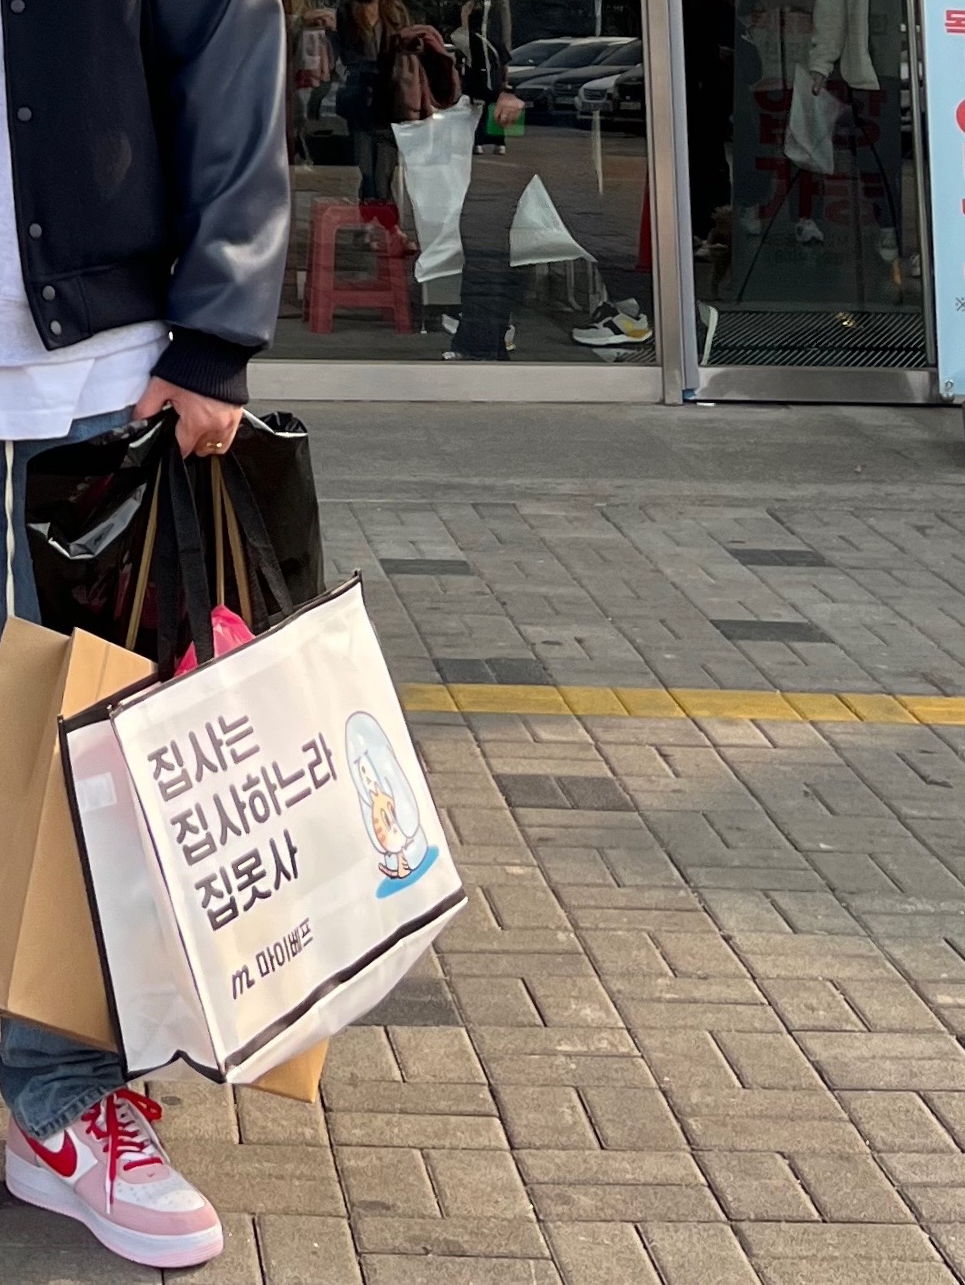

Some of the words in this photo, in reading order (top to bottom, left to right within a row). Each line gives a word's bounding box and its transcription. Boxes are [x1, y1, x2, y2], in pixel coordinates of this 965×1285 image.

[147, 713, 261, 802] 집사는
[169, 731, 339, 866] 집사하느라
[193, 828, 300, 932] 집못사
